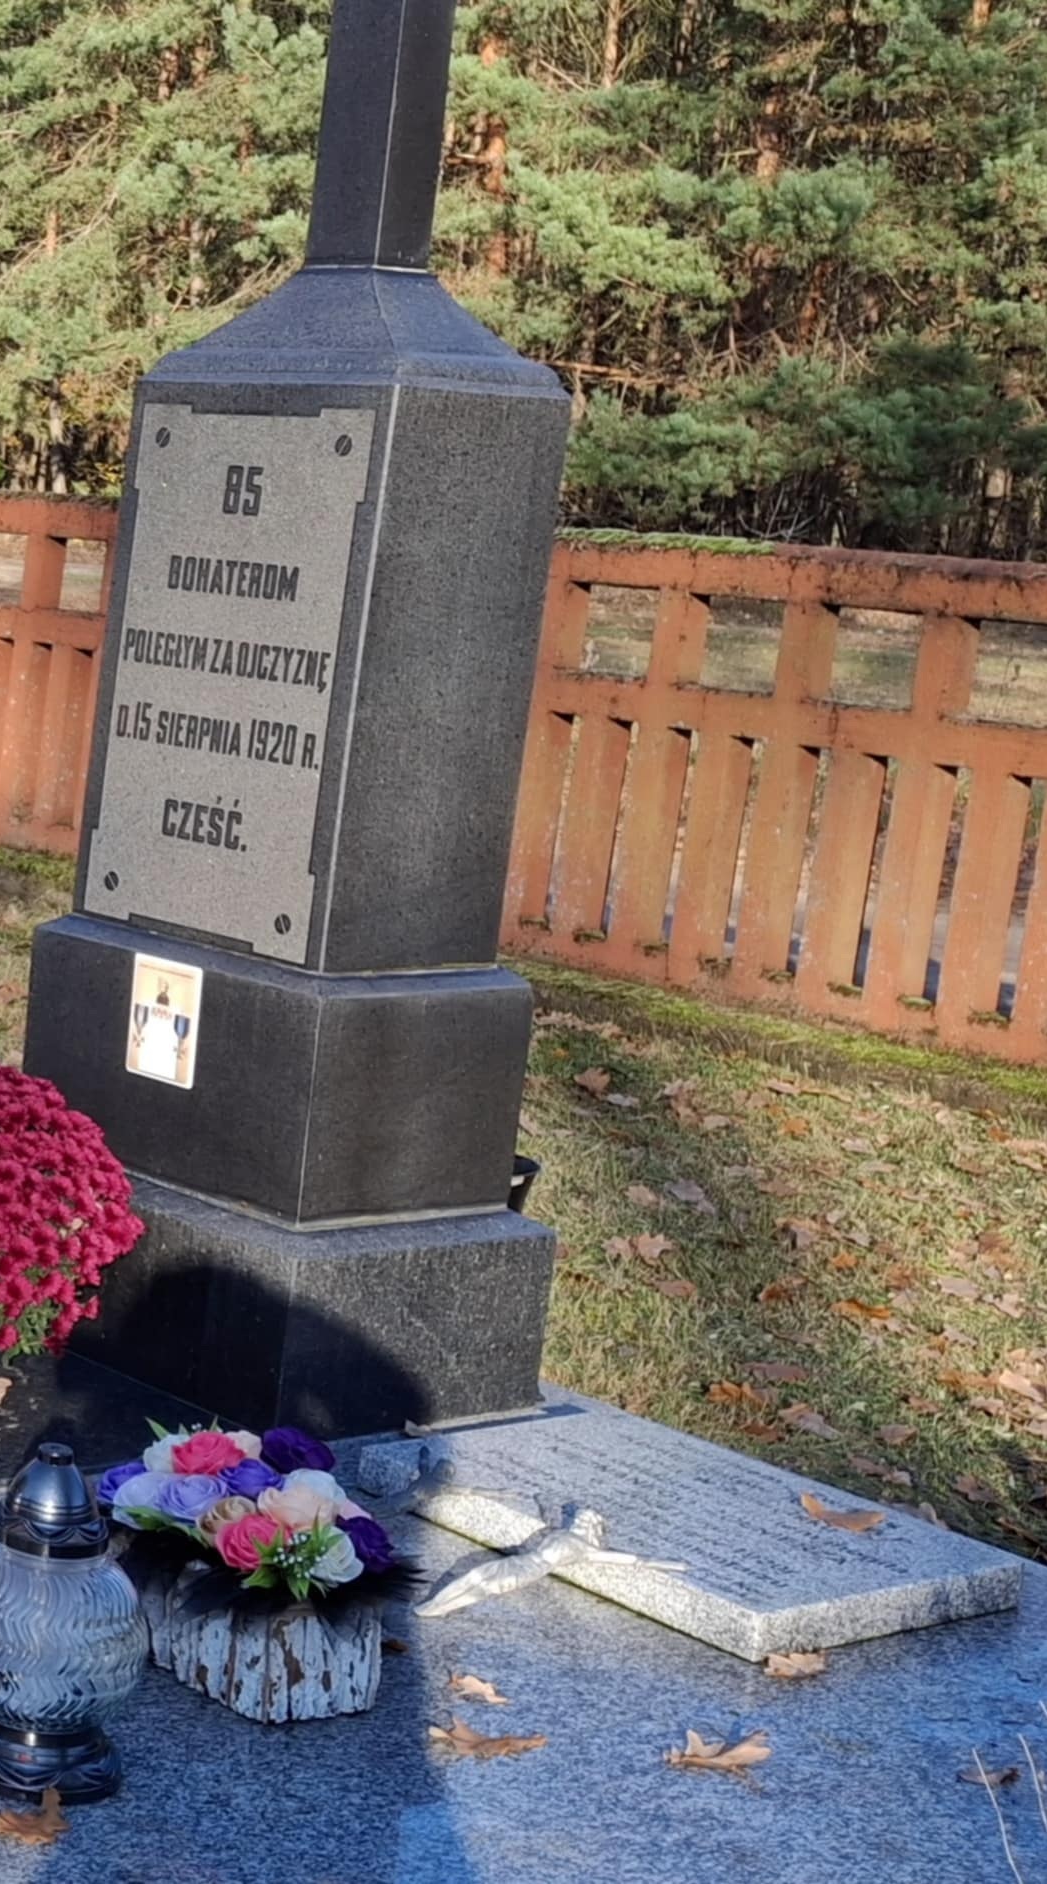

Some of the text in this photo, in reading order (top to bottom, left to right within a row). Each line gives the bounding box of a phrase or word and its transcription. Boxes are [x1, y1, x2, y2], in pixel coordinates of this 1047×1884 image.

[222, 465, 264, 517] 85
[167, 555, 300, 602] BOHATEROM
[123, 628, 332, 694] POLEGŁYM ZA OJCZYZNĘ
[156, 710, 241, 757] SIERPNIA
[247, 718, 298, 766] 1920
[301, 733, 319, 770] R.
[161, 795, 247, 852] CZEŚĆ.
